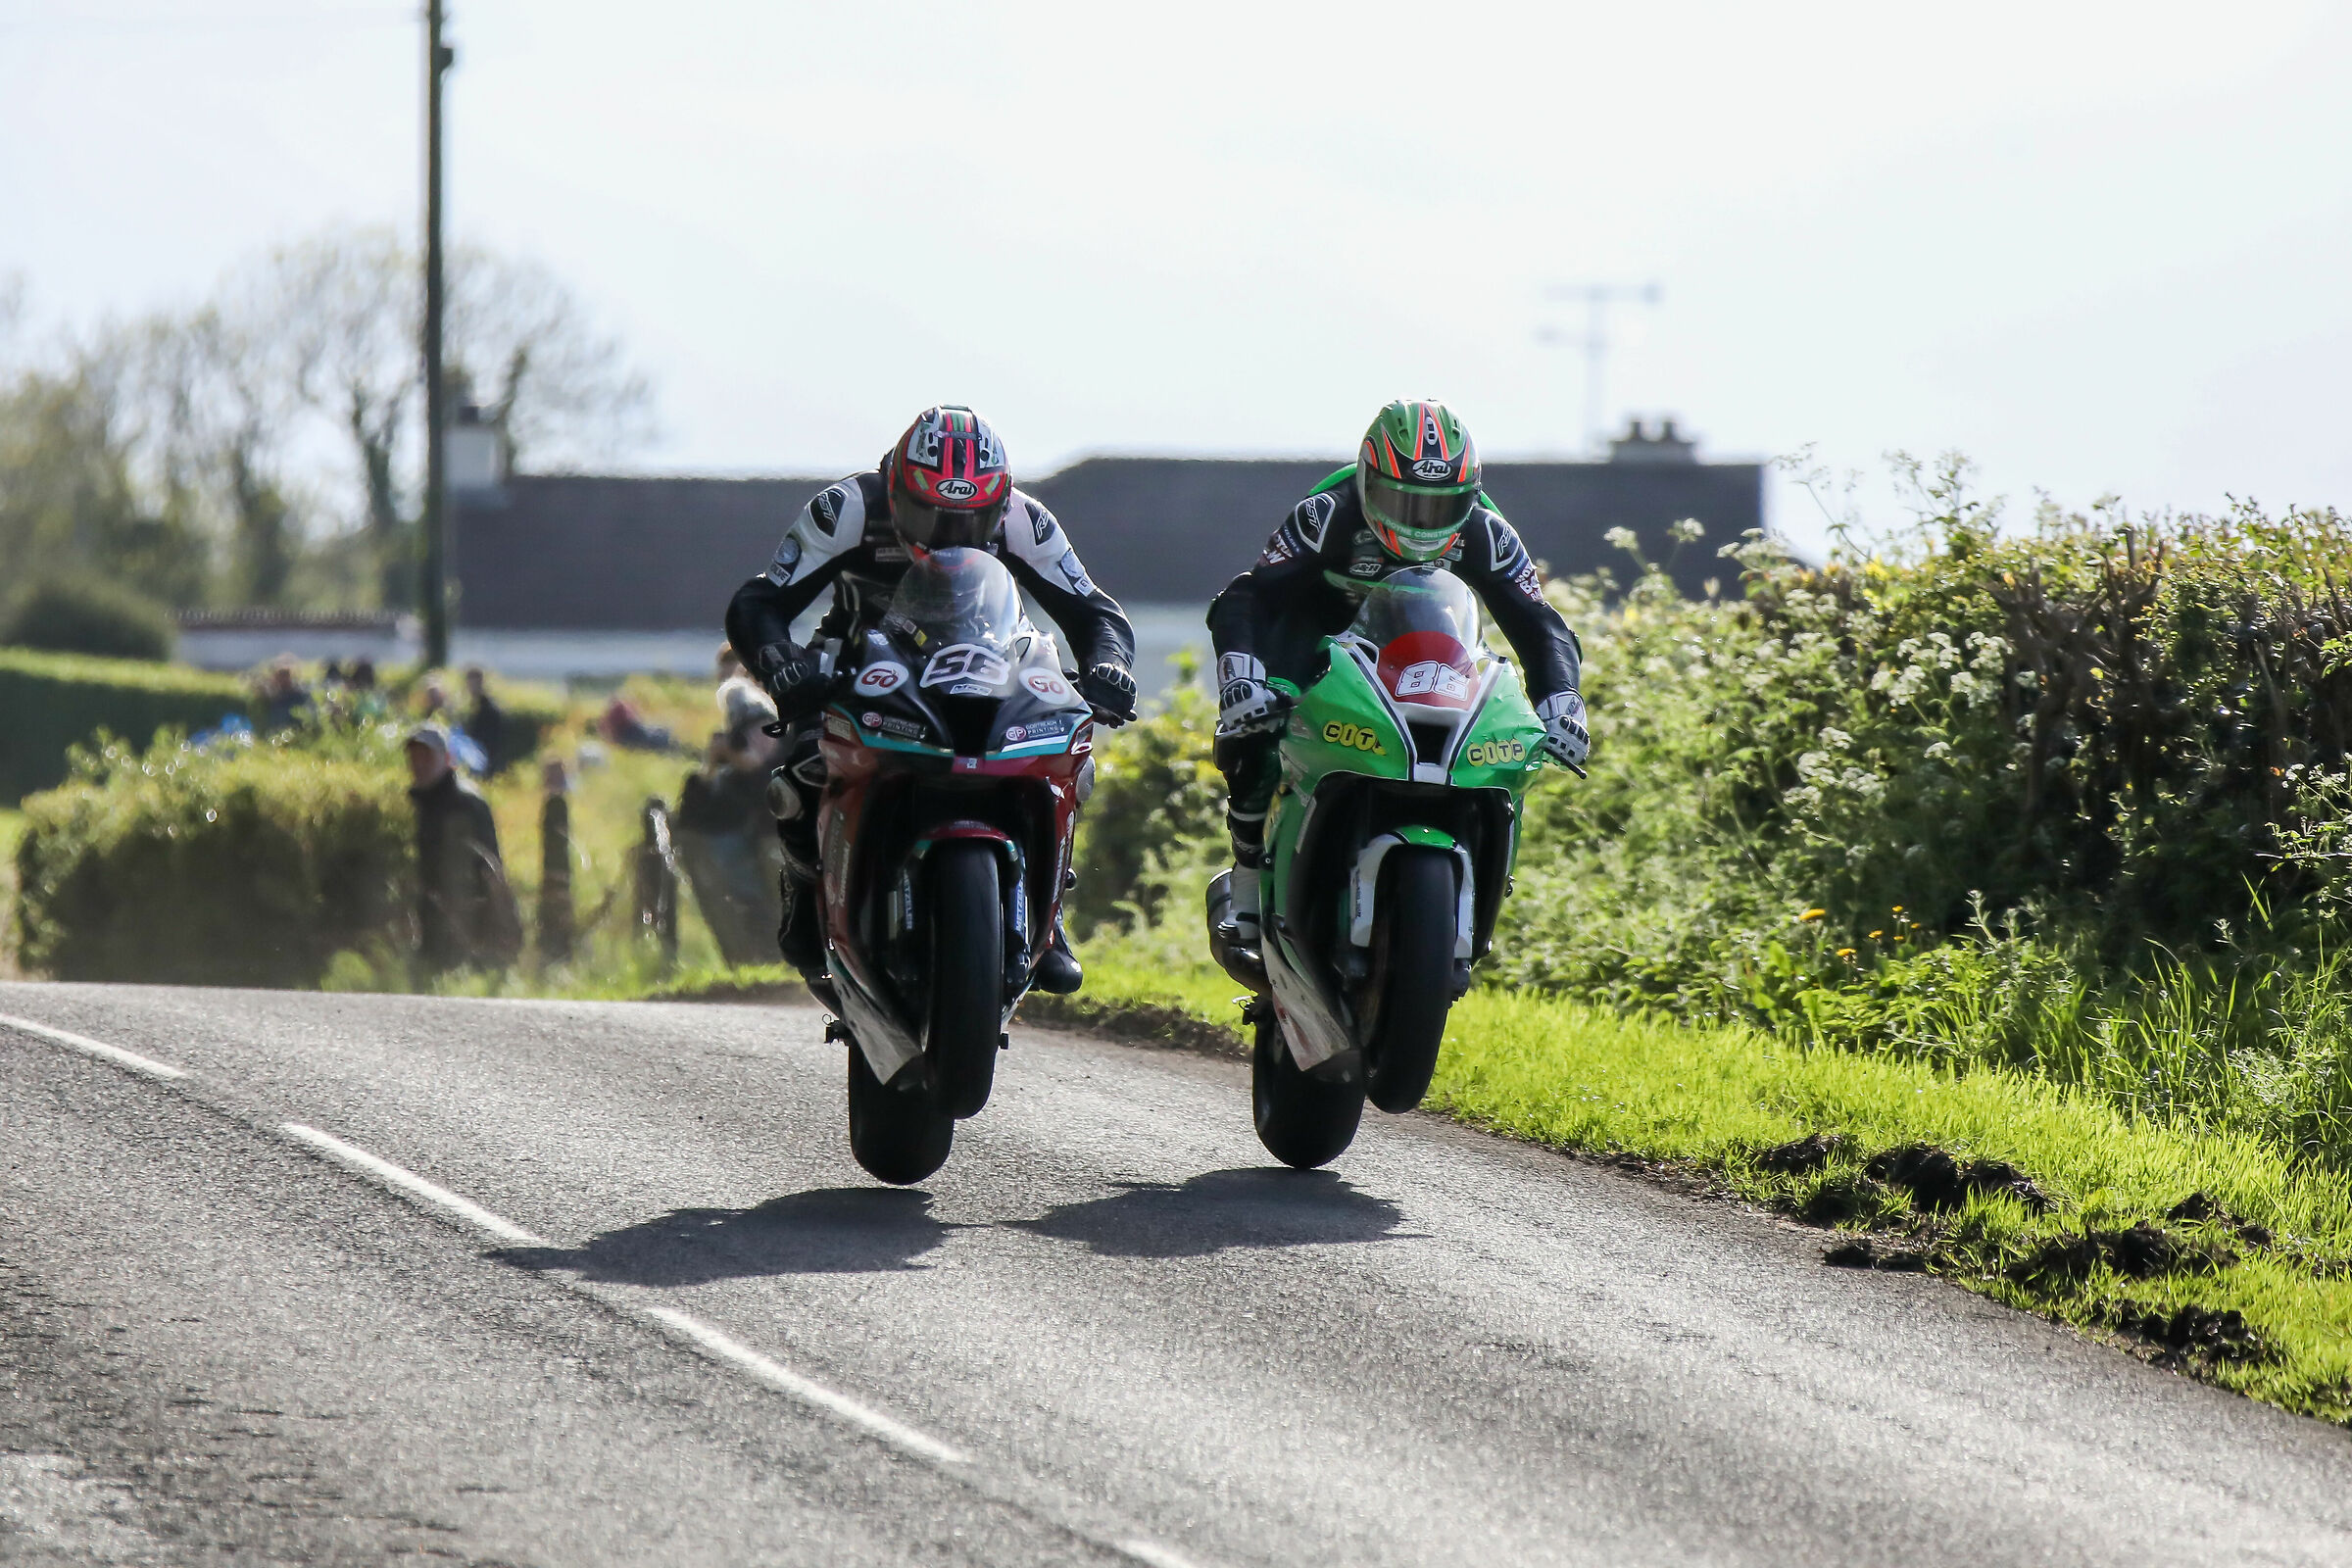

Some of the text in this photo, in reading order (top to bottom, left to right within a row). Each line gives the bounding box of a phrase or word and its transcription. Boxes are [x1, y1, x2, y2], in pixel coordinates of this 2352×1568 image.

[1413, 460, 1449, 473] Arai
[939, 481, 972, 495] Arai
[1386, 519, 1411, 536] DOYNE
[922, 646, 1009, 686] 56
[1396, 661, 1469, 701] 86
[1007, 727, 1025, 740] GP
[1027, 726, 1058, 735] PRINTING
[1468, 742, 1524, 763] CITP
